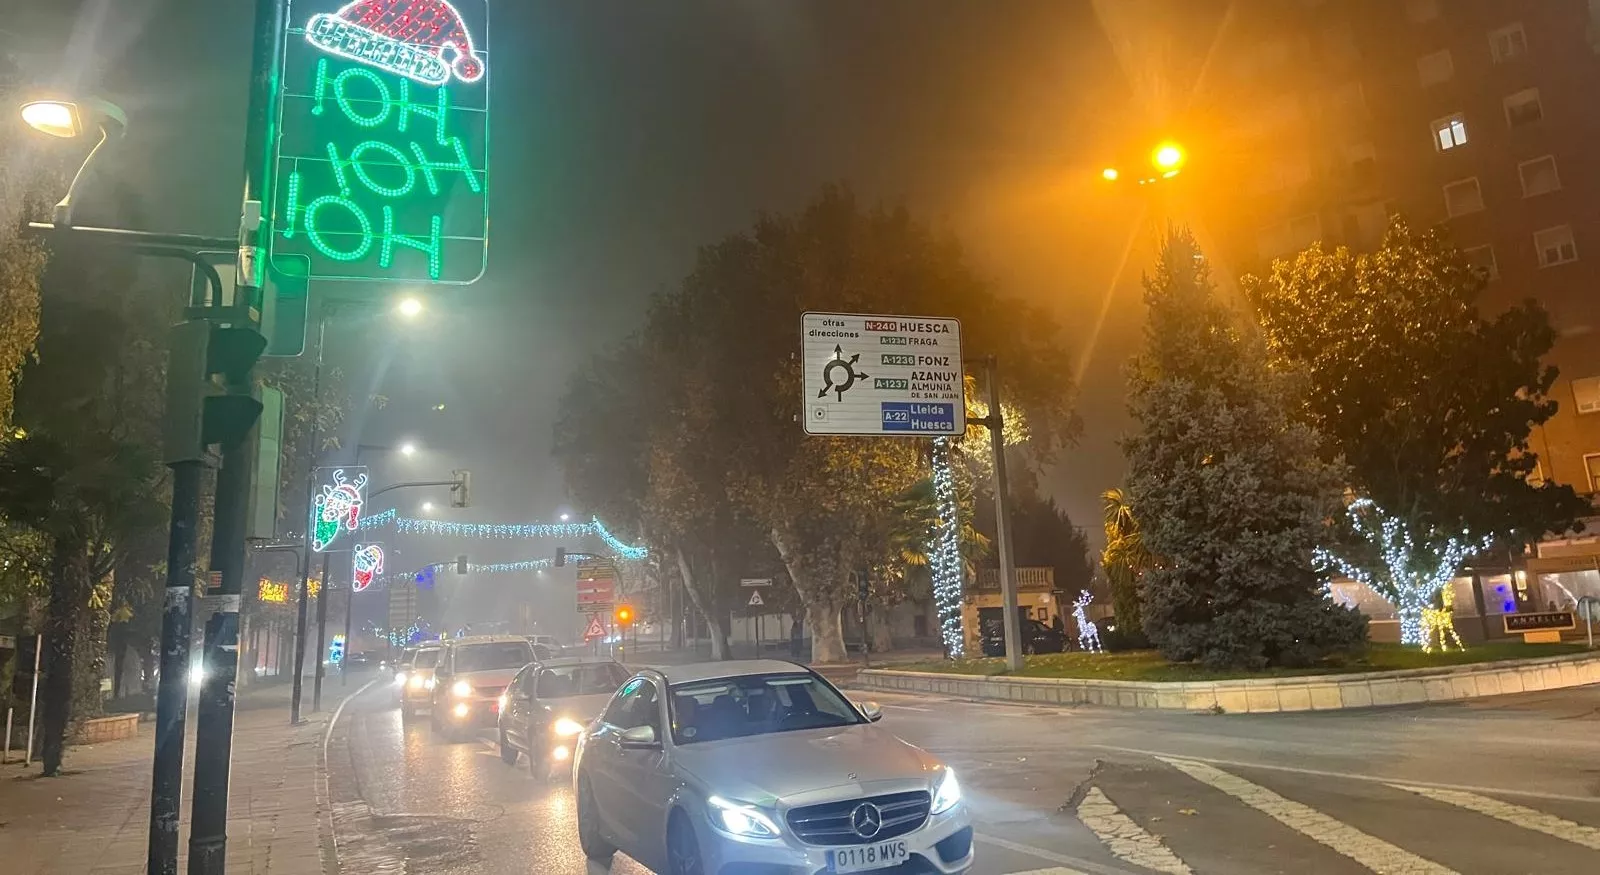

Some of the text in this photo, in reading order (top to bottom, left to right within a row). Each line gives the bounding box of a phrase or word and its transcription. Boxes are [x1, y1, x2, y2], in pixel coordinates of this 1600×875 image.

[822, 319, 845, 327] otras
[866, 322, 950, 333] N-240 HUESCA
[809, 329, 859, 338] direcciones
[908, 337, 938, 346] FRAGA
[882, 355, 950, 366] A-1236 FONZ
[911, 371, 957, 381] AZANUY
[875, 380, 908, 389] A-1237
[911, 383, 952, 391] ALMUNIA
[911, 404, 944, 414] Lleida
[885, 413, 907, 421] A-22
[911, 419, 953, 430] Huesca
[838, 842, 906, 867] 0118 MVS
